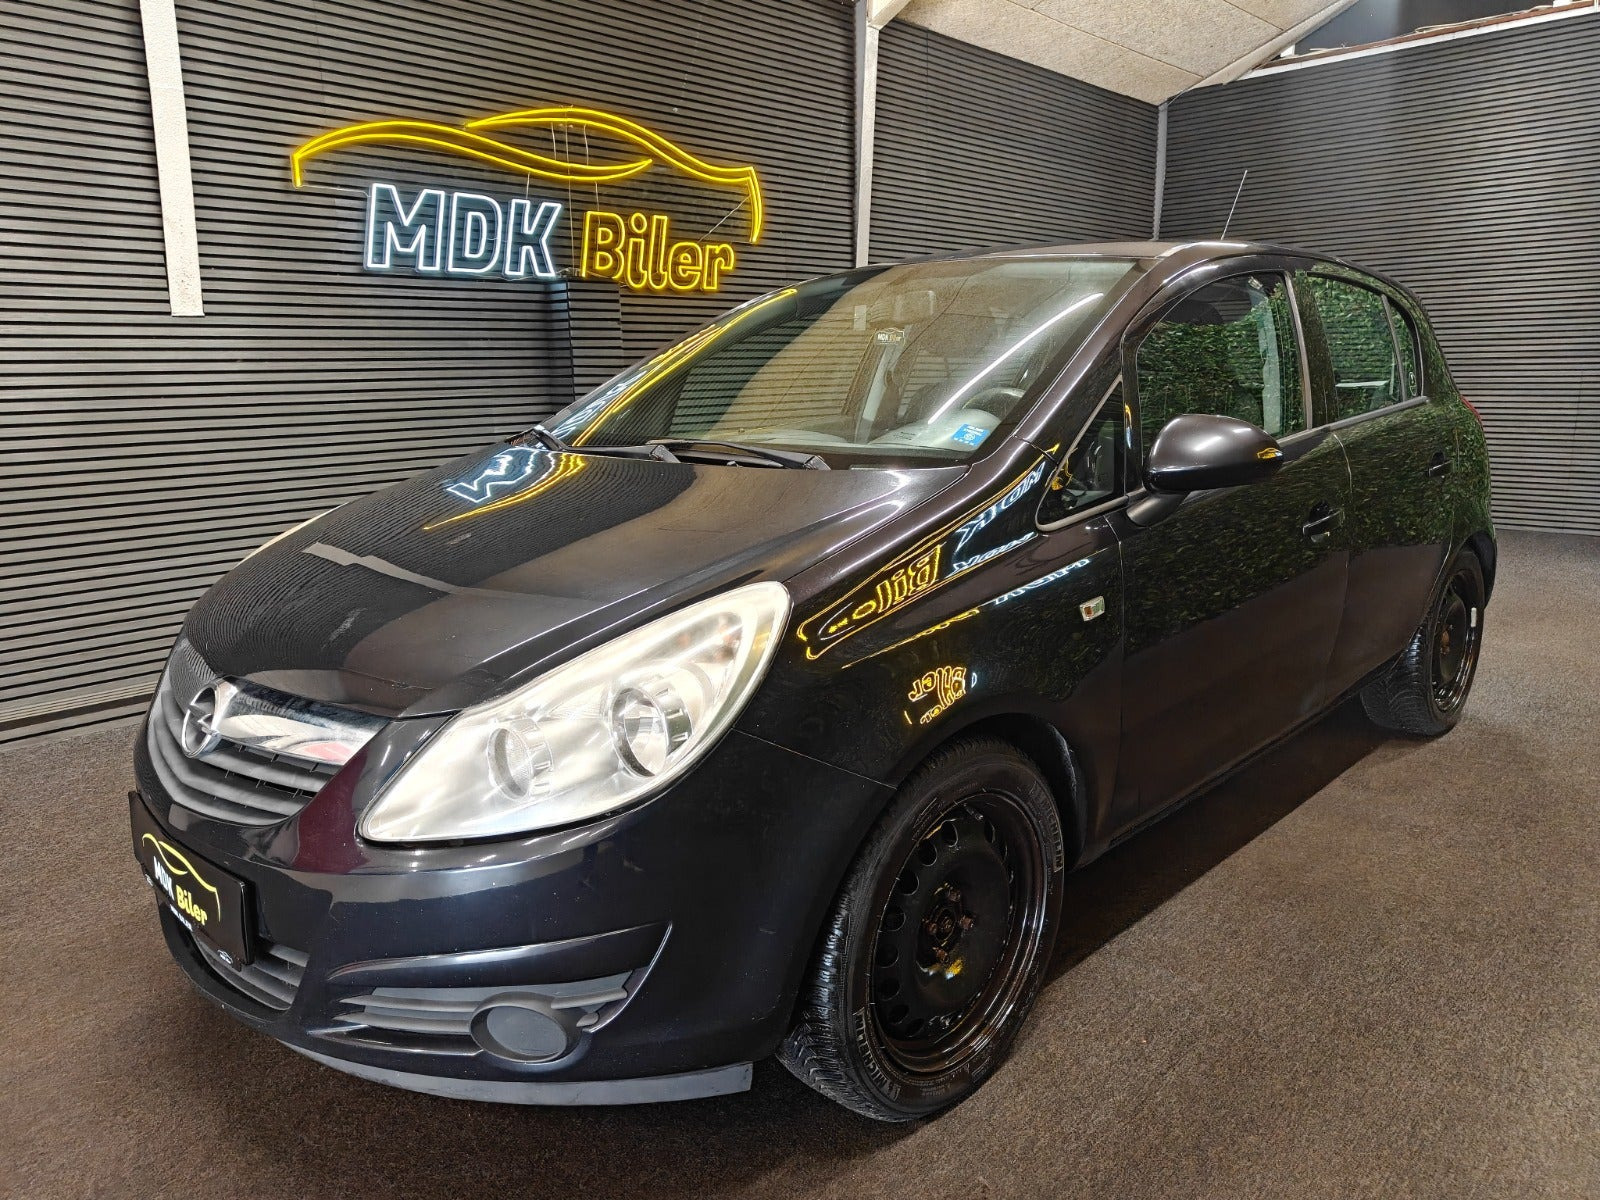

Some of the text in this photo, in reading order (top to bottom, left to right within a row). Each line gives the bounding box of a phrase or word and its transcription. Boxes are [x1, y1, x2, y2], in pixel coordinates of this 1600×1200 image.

[365, 181, 736, 292] MDK Biler
[175, 884, 208, 926] Biler
